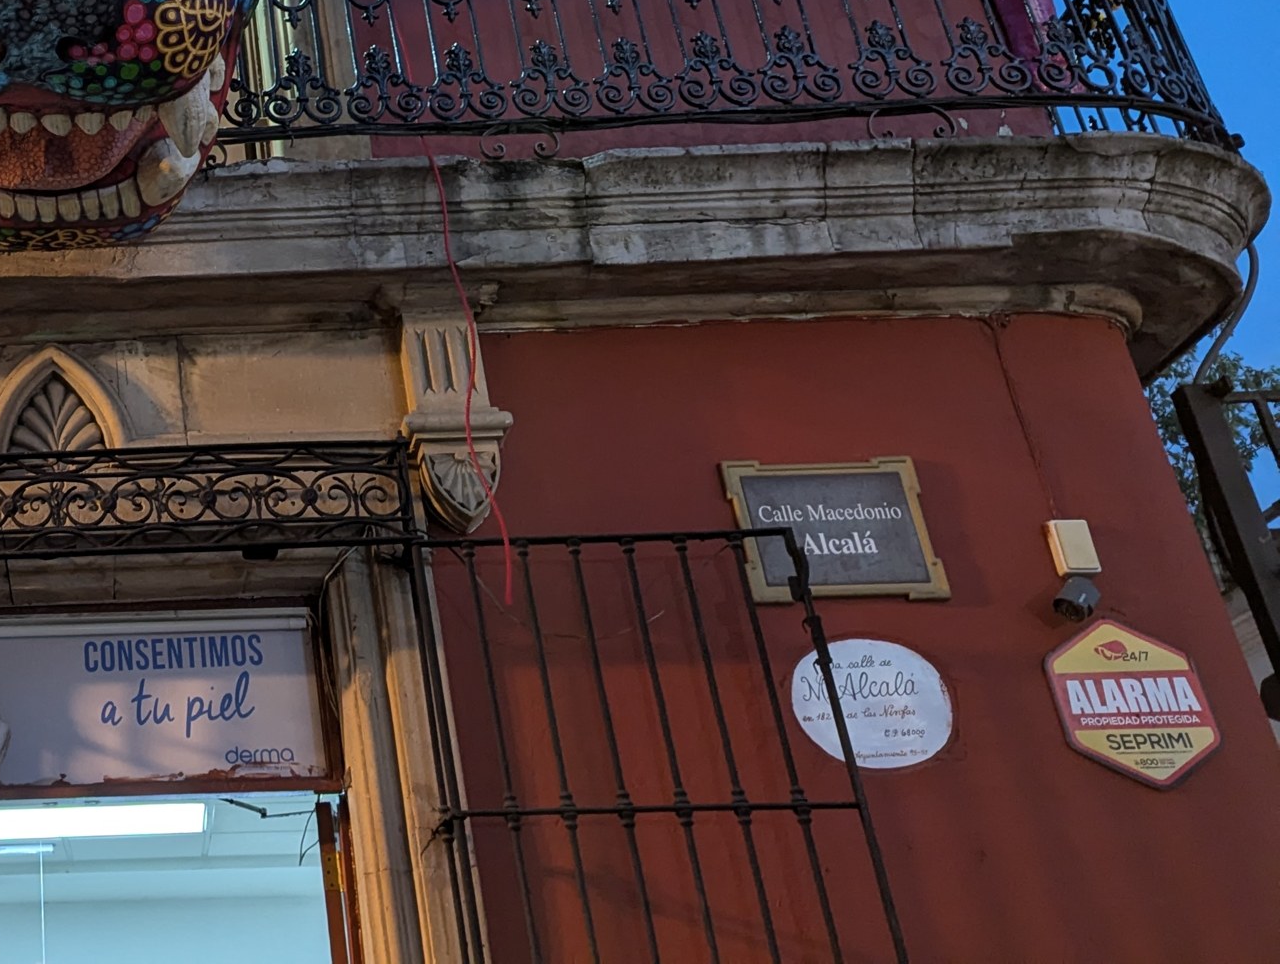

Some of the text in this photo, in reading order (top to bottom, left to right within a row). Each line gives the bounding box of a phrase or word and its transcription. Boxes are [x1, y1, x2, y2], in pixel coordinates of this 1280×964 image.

[758, 502, 903, 523] Calle Macedonio
[803, 530, 879, 555] Alcalá
[83, 634, 264, 673] CONSENTIMOS
[846, 654, 875, 669] calle
[878, 658, 892, 667] de
[100, 670, 256, 738] a tu piel
[1066, 677, 1202, 715] ALARMA
[1080, 714, 1201, 727] PROPIEDAD PROTEGIDA
[1106, 732, 1193, 751] SEPRIMI
[225, 746, 295, 764] derma
